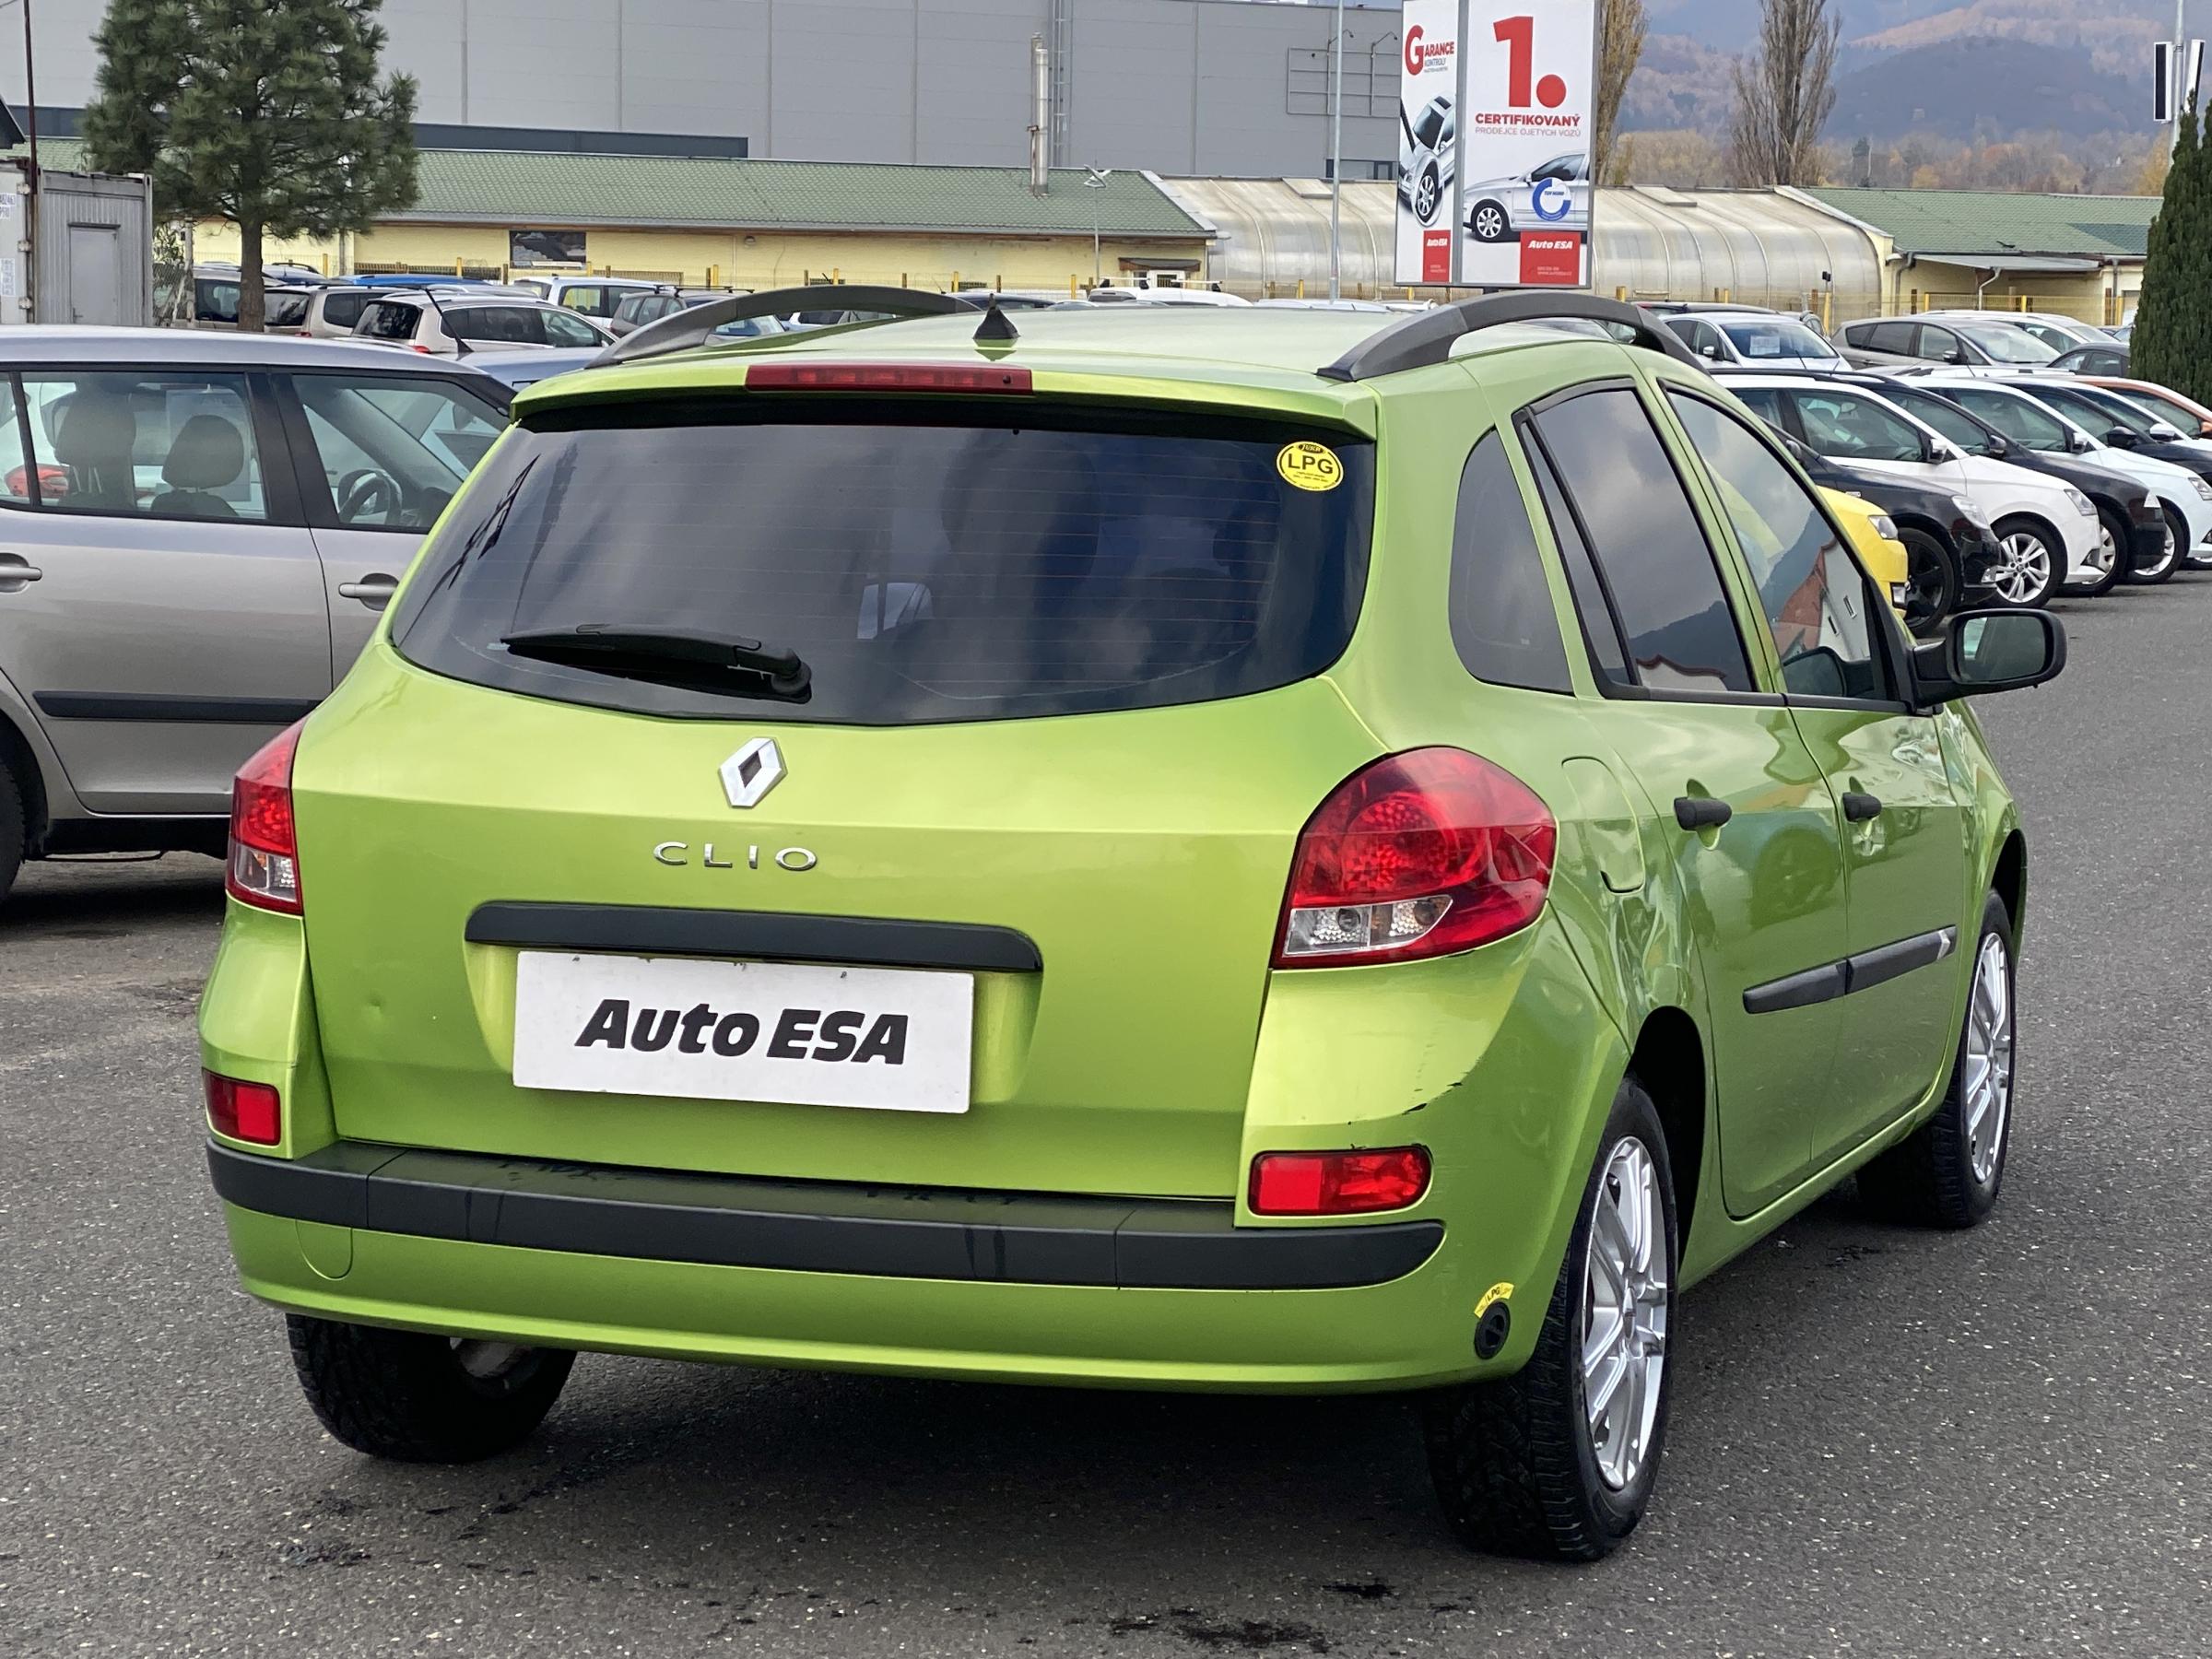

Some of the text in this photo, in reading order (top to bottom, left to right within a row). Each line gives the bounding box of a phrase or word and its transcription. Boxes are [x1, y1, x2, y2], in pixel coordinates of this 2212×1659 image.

[1406, 25, 1454, 76] GARANCE
[1493, 16, 1567, 108] 1.
[1475, 113, 1581, 127] CERTIFIKOVANÝ
[1475, 127, 1518, 135] PRODEJCE
[1528, 241, 1573, 249] Auto ESA
[1288, 453, 1333, 474] LPG
[653, 841, 818, 871] CLIO
[574, 998, 909, 1065] Auto ESA
[1487, 1287, 1500, 1301] LPG
